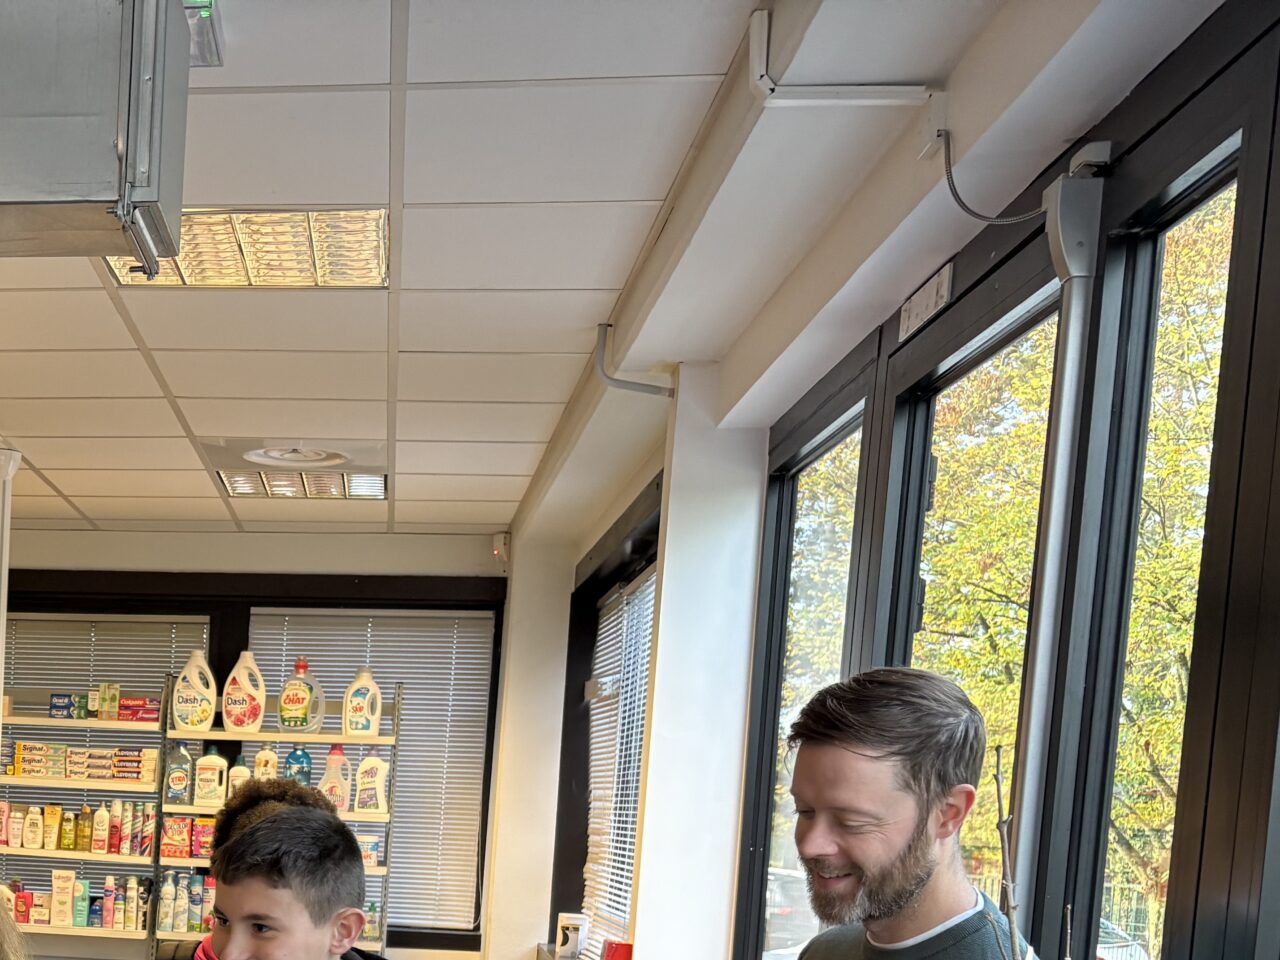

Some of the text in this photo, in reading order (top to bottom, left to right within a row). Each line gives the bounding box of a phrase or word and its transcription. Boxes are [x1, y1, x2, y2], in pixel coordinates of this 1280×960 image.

[177, 695, 199, 705] Dash
[226, 697, 247, 706] Dash
[283, 696, 306, 705] CHAT
[22, 744, 45, 753] Signal
[69, 750, 87, 758] Signal
[21, 757, 43, 765] Signal
[68, 759, 85, 767] Signal
[21, 768, 43, 776] Signal
[68, 769, 87, 777] Signal
